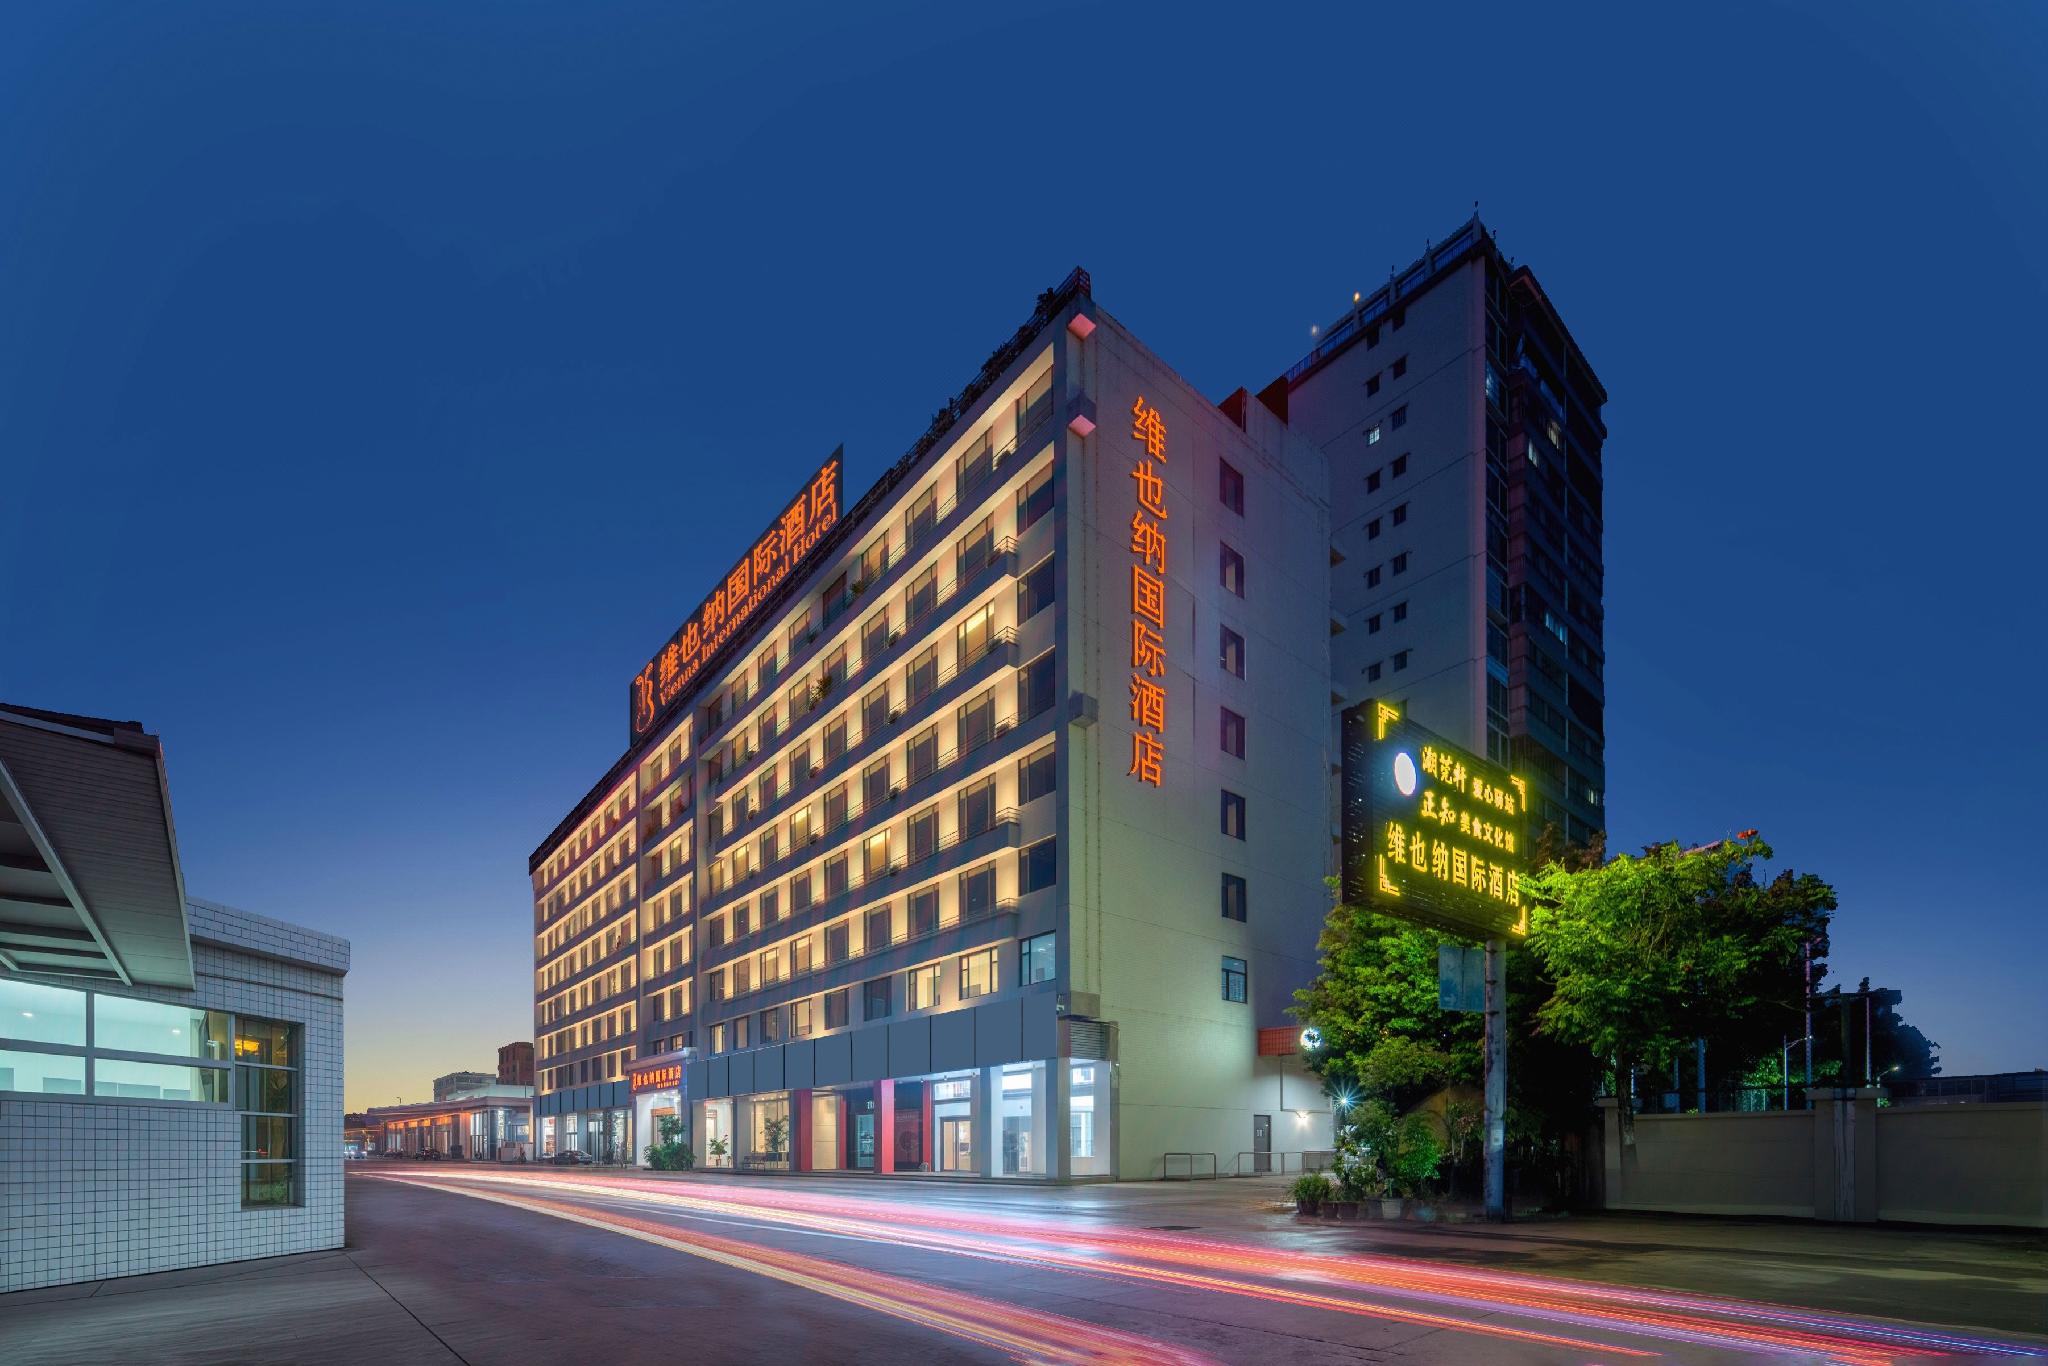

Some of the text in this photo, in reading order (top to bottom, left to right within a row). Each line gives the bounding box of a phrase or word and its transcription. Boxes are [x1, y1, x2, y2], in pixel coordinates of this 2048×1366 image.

[659, 459, 838, 689] 维也纳国际酒店
[660, 502, 837, 706] Vienna International Hotel
[1130, 396, 1168, 786] 维也纳国际酒店
[1387, 821, 1520, 906] 维也纳国际酒店
